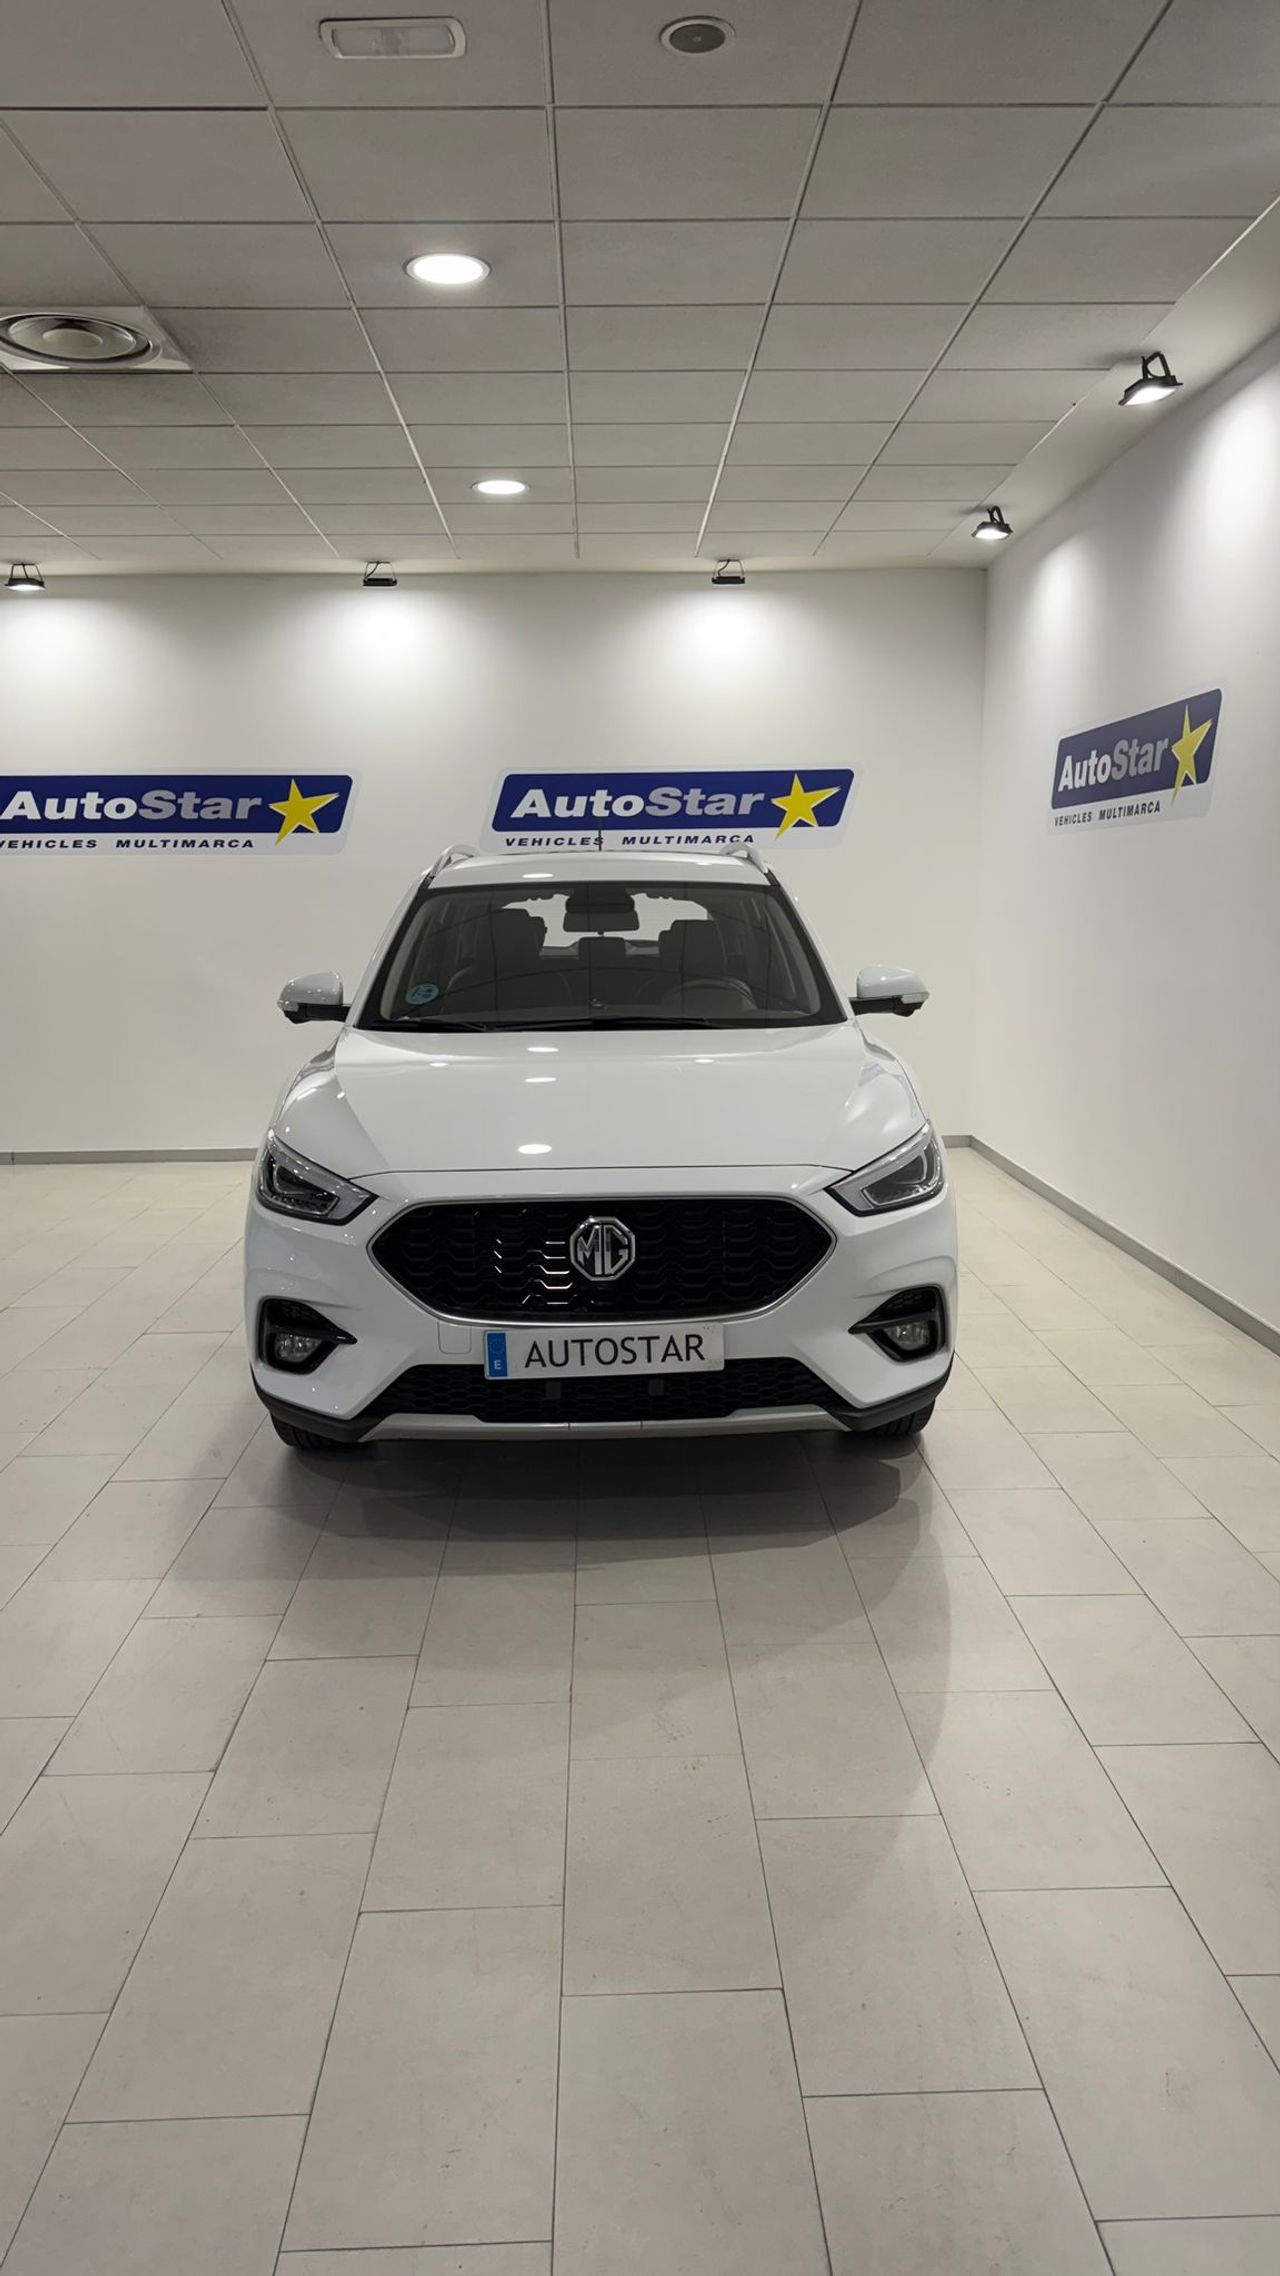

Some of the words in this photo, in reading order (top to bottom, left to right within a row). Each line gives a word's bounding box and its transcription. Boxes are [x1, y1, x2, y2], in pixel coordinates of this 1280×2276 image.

[1058, 739, 1169, 792] AutoStar
[0, 790, 262, 820] AutoStar
[510, 787, 765, 818] AutoStar
[1055, 811, 1092, 827] VEHICLES
[1099, 801, 1161, 820] MULTIMARCA
[116, 839, 254, 849] MULTIMARCA
[506, 837, 604, 847] VEHICLES
[622, 835, 754, 845] MULTIMARCA
[577, 1225, 629, 1275] MG
[494, 1359, 502, 1370] E
[524, 1334, 705, 1369] AUTOSTAR
